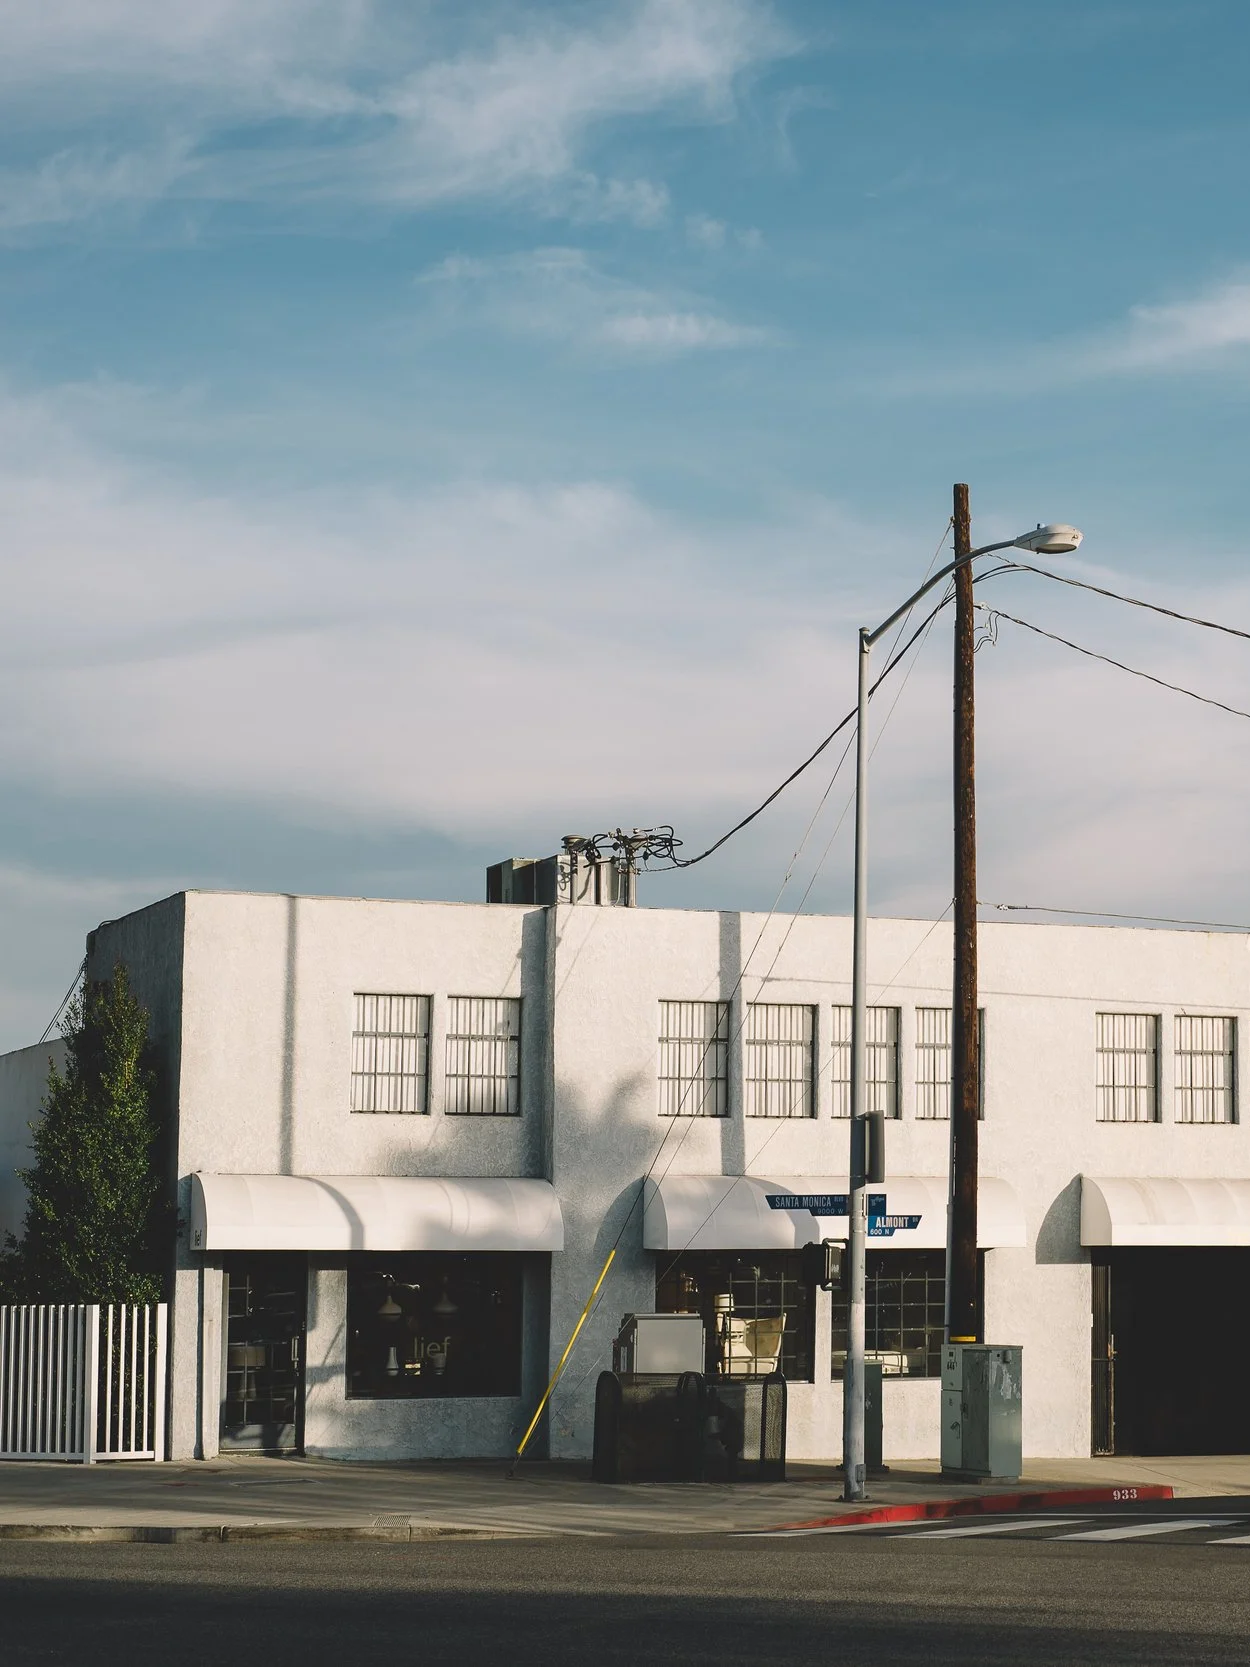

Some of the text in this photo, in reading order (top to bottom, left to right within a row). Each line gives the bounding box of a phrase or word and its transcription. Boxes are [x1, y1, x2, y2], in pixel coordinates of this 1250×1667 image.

[775, 1196, 800, 1208] SANTA
[802, 1196, 832, 1208] MONICA
[875, 1216, 909, 1228] ALMONT
[414, 1336, 451, 1359] lief
[1112, 1488, 1138, 1501] 933
